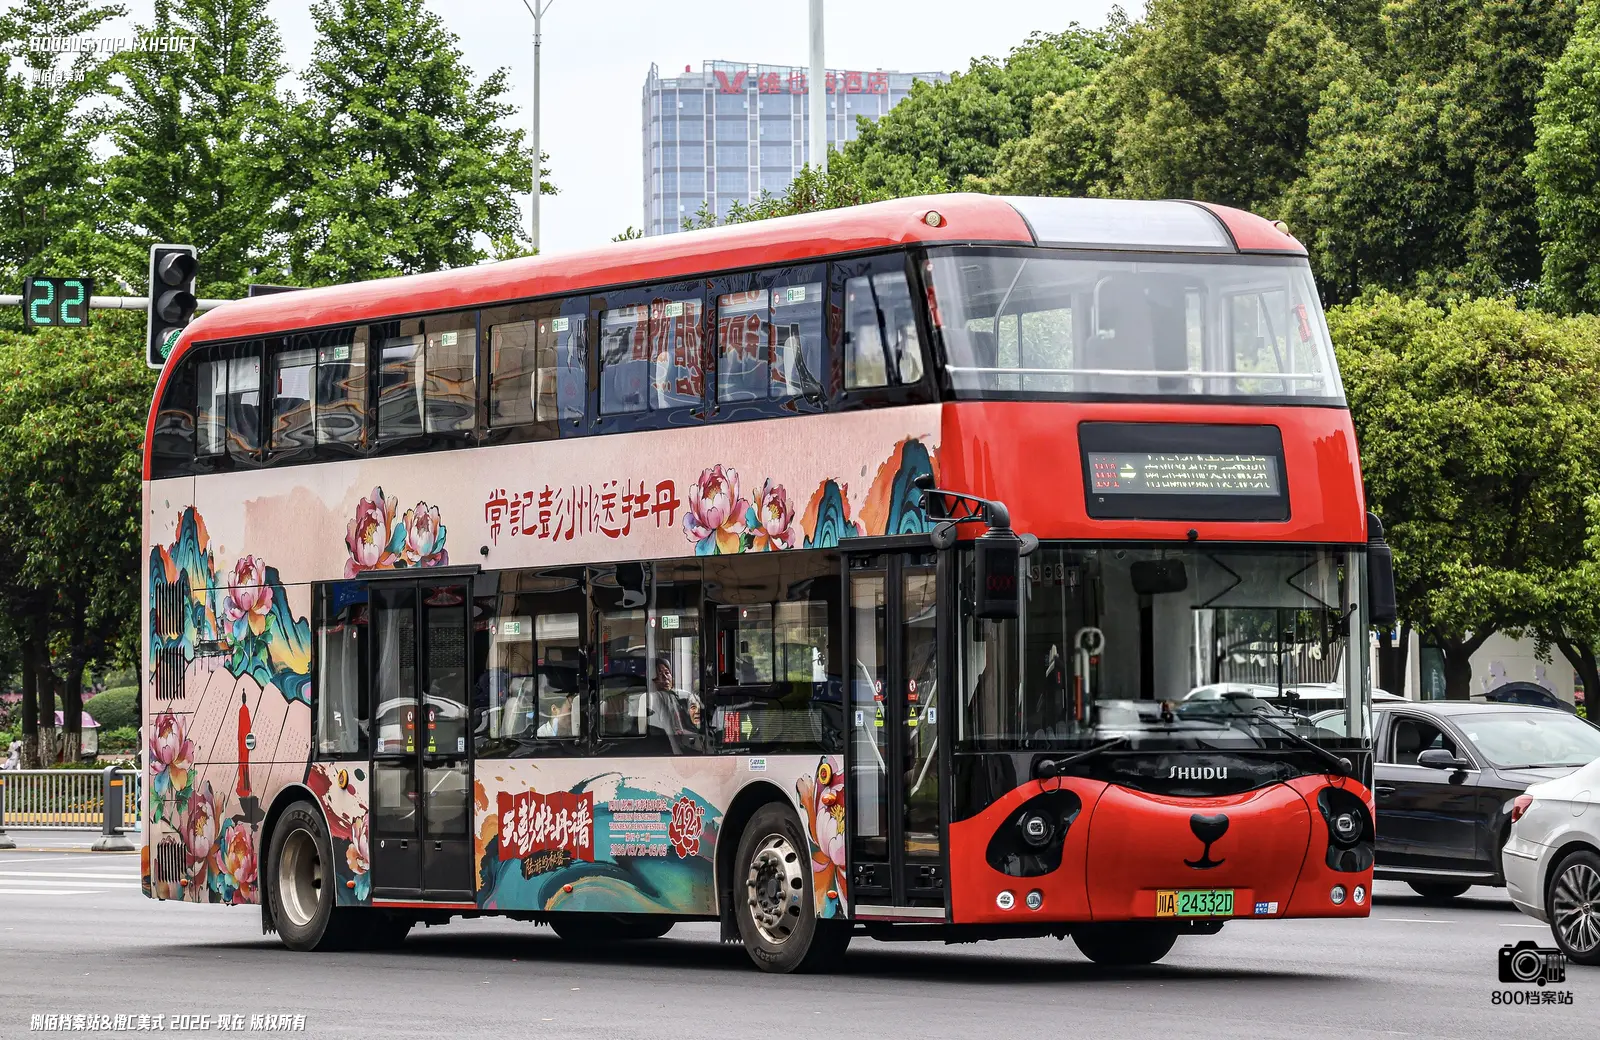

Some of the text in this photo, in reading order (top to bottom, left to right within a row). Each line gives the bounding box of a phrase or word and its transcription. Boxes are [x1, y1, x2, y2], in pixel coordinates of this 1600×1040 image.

[30, 280, 84, 323] 22
[1168, 765, 1228, 780] SHUDU
[1181, 894, 1233, 913] 24332D
